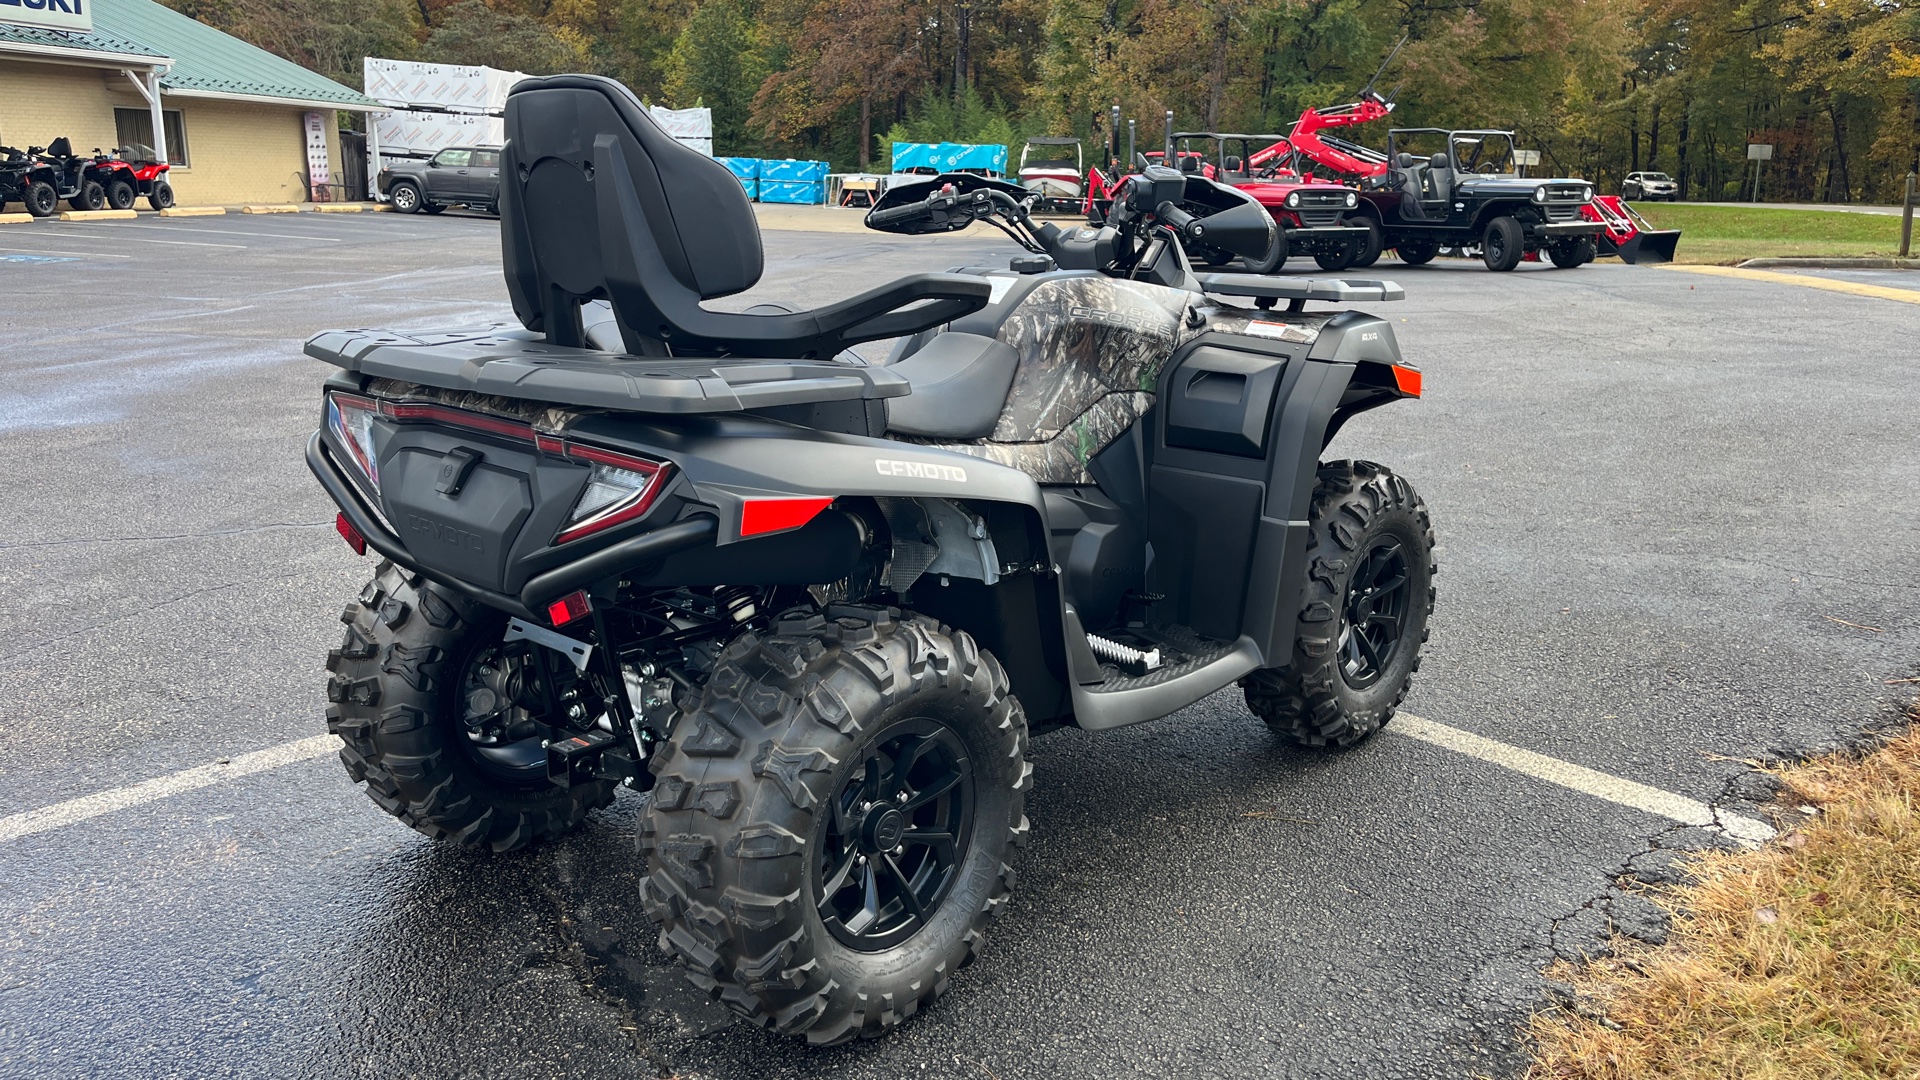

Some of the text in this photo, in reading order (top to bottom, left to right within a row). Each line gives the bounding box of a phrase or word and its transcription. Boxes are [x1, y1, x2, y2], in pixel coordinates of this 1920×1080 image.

[1069, 306, 1171, 336] CFORCE
[875, 459, 967, 483] CFMOTO
[407, 513, 486, 555] CFMOTO
